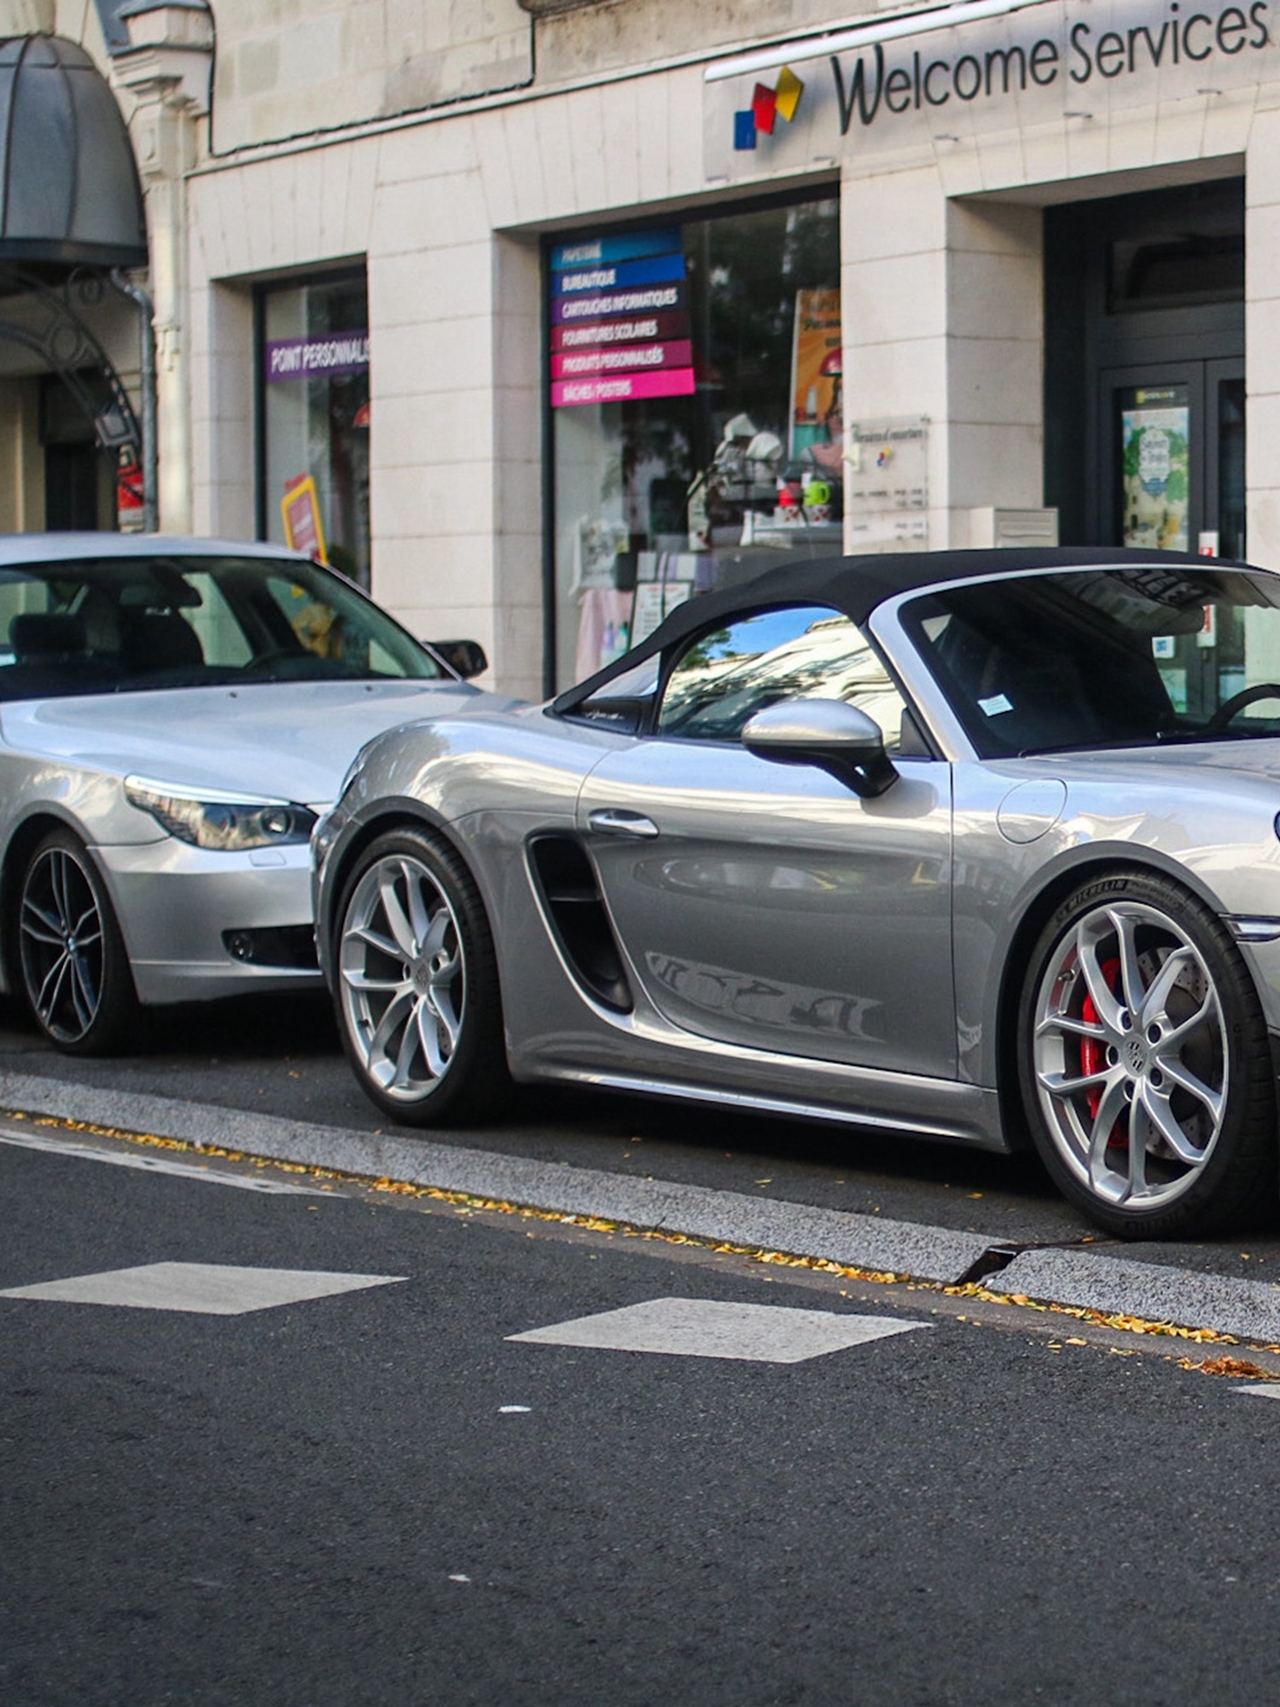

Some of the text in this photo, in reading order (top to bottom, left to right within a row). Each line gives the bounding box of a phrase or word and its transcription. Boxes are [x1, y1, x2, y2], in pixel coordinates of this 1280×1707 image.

[831, 40, 1059, 135] Welcome
[1070, 2, 1269, 84] Services
[271, 344, 302, 374] POINT
